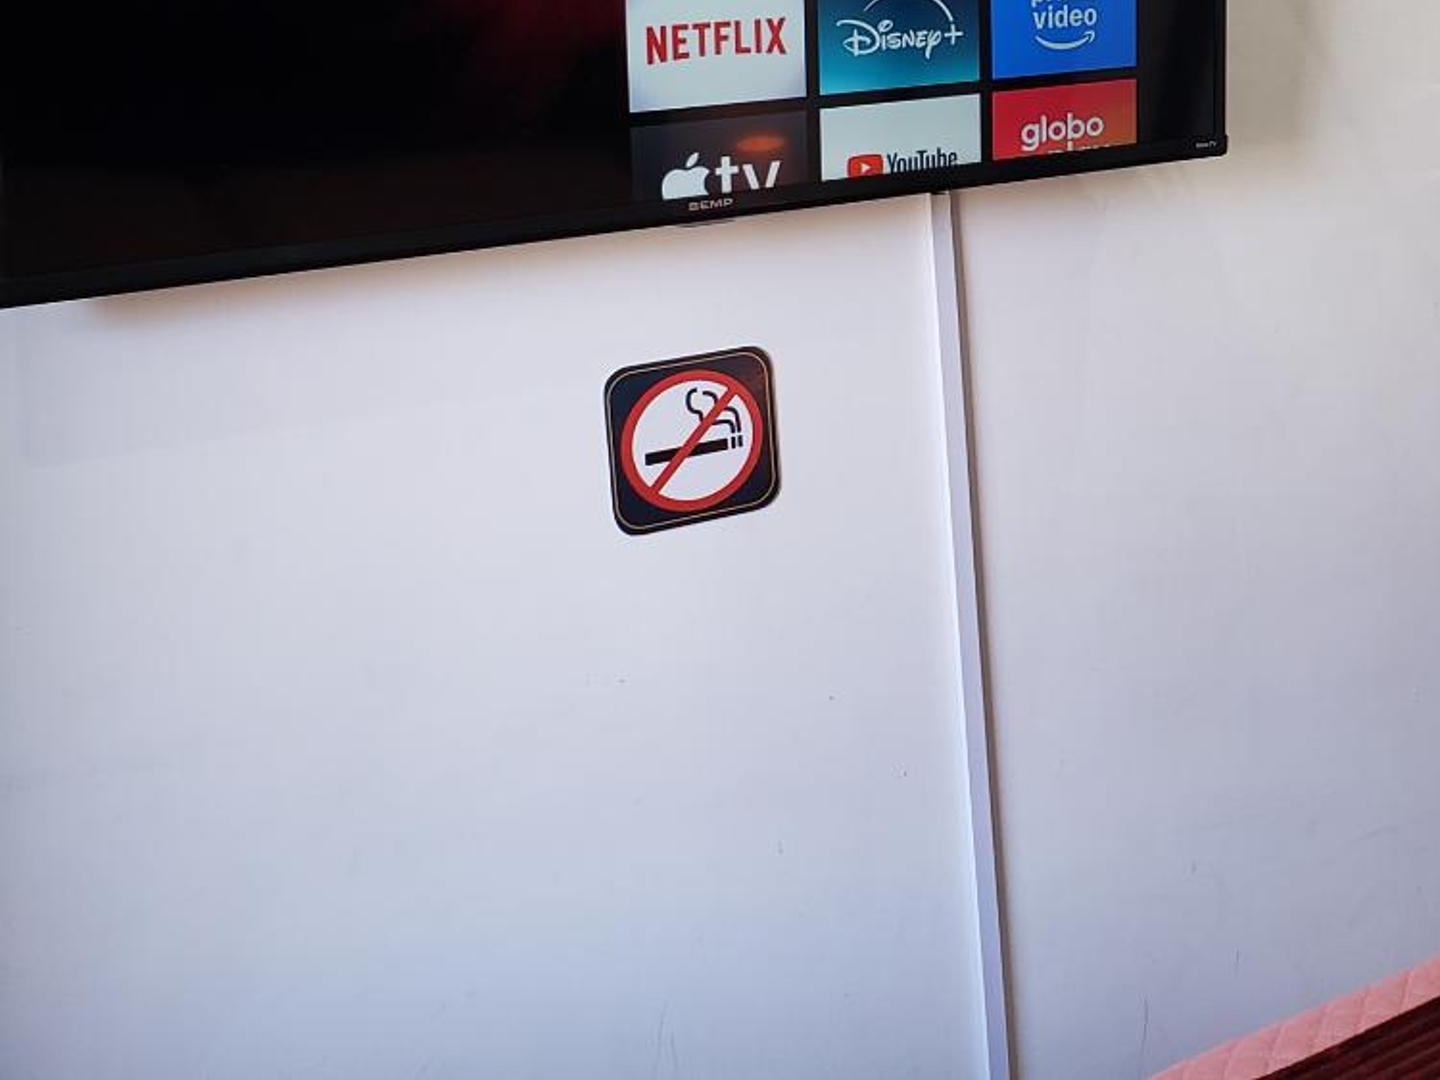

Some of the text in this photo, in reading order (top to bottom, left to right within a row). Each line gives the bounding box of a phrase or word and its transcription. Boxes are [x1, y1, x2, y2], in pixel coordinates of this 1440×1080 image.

[1032, 5, 1097, 29] video
[646, 17, 786, 65] NETFLIX
[1021, 112, 1104, 151] globo
[715, 156, 780, 193] tv
[887, 147, 957, 174] YouTube
